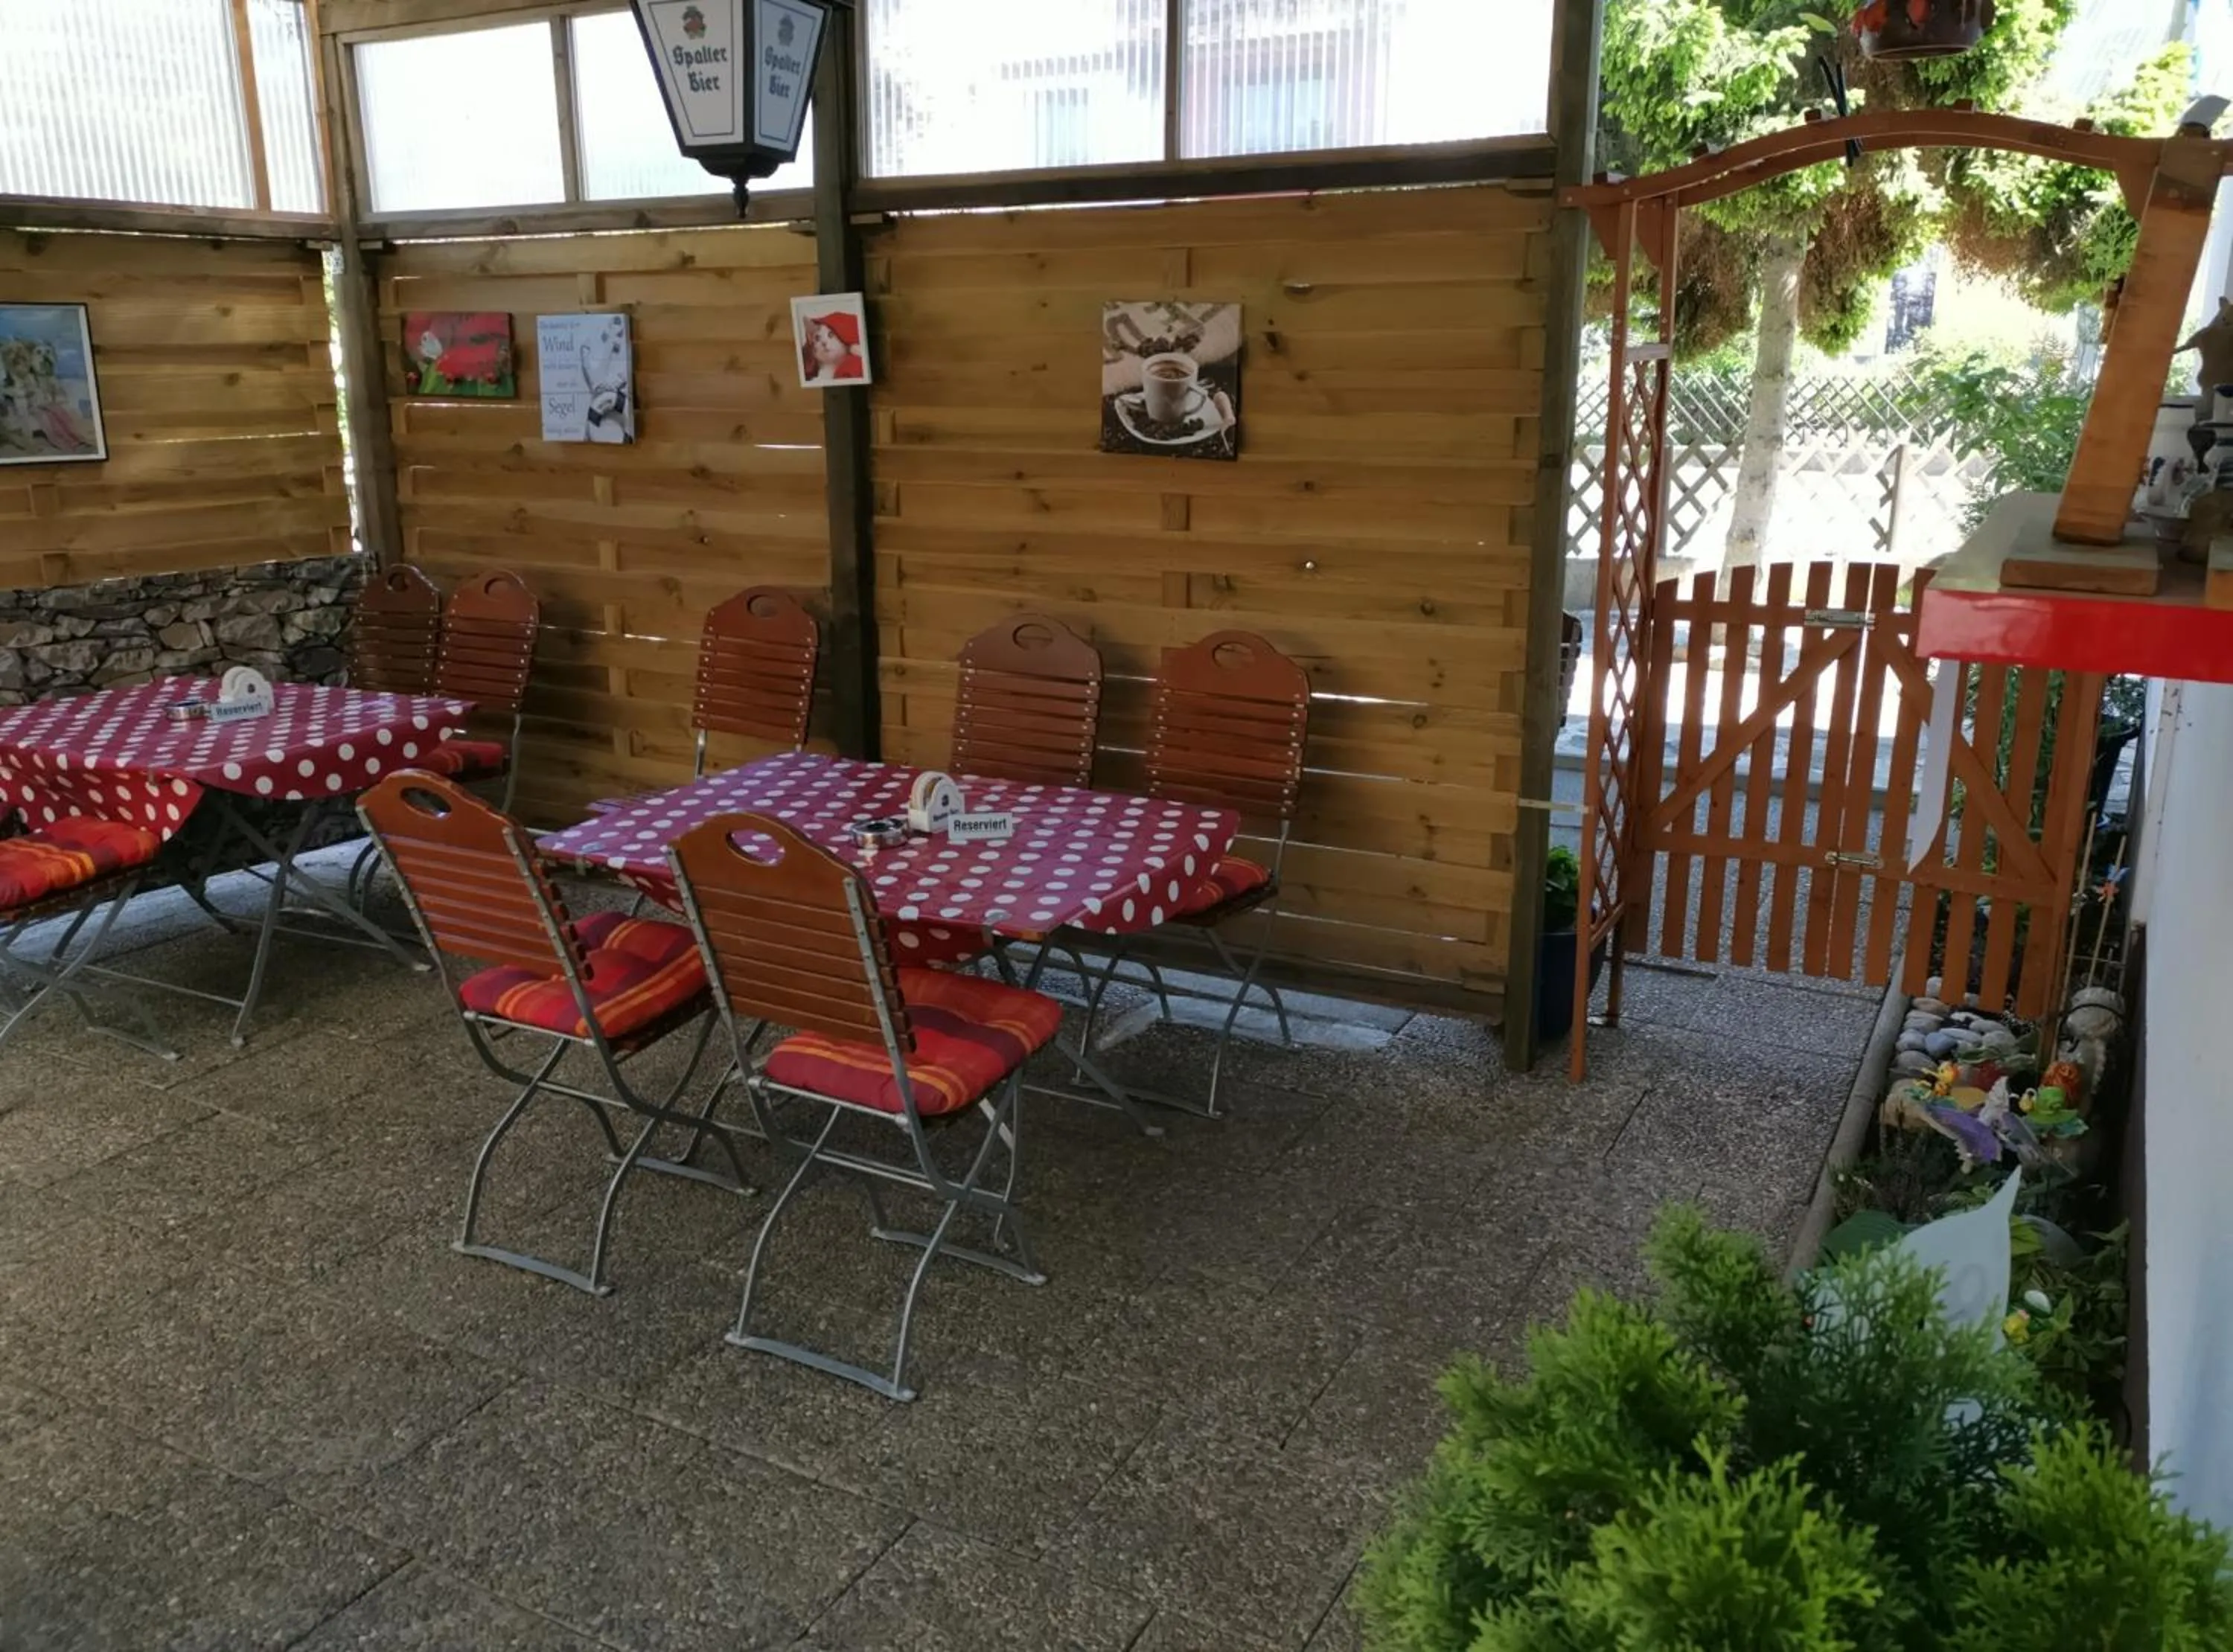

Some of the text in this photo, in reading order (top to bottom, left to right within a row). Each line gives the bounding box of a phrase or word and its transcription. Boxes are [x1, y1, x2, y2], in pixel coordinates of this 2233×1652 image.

[672, 45, 727, 68] Spalter
[687, 71, 720, 92] Bier
[769, 75, 790, 98] Bier
[543, 333, 575, 352] Wind
[548, 393, 575, 418] Segel
[953, 818, 1007, 832] Reserviert
